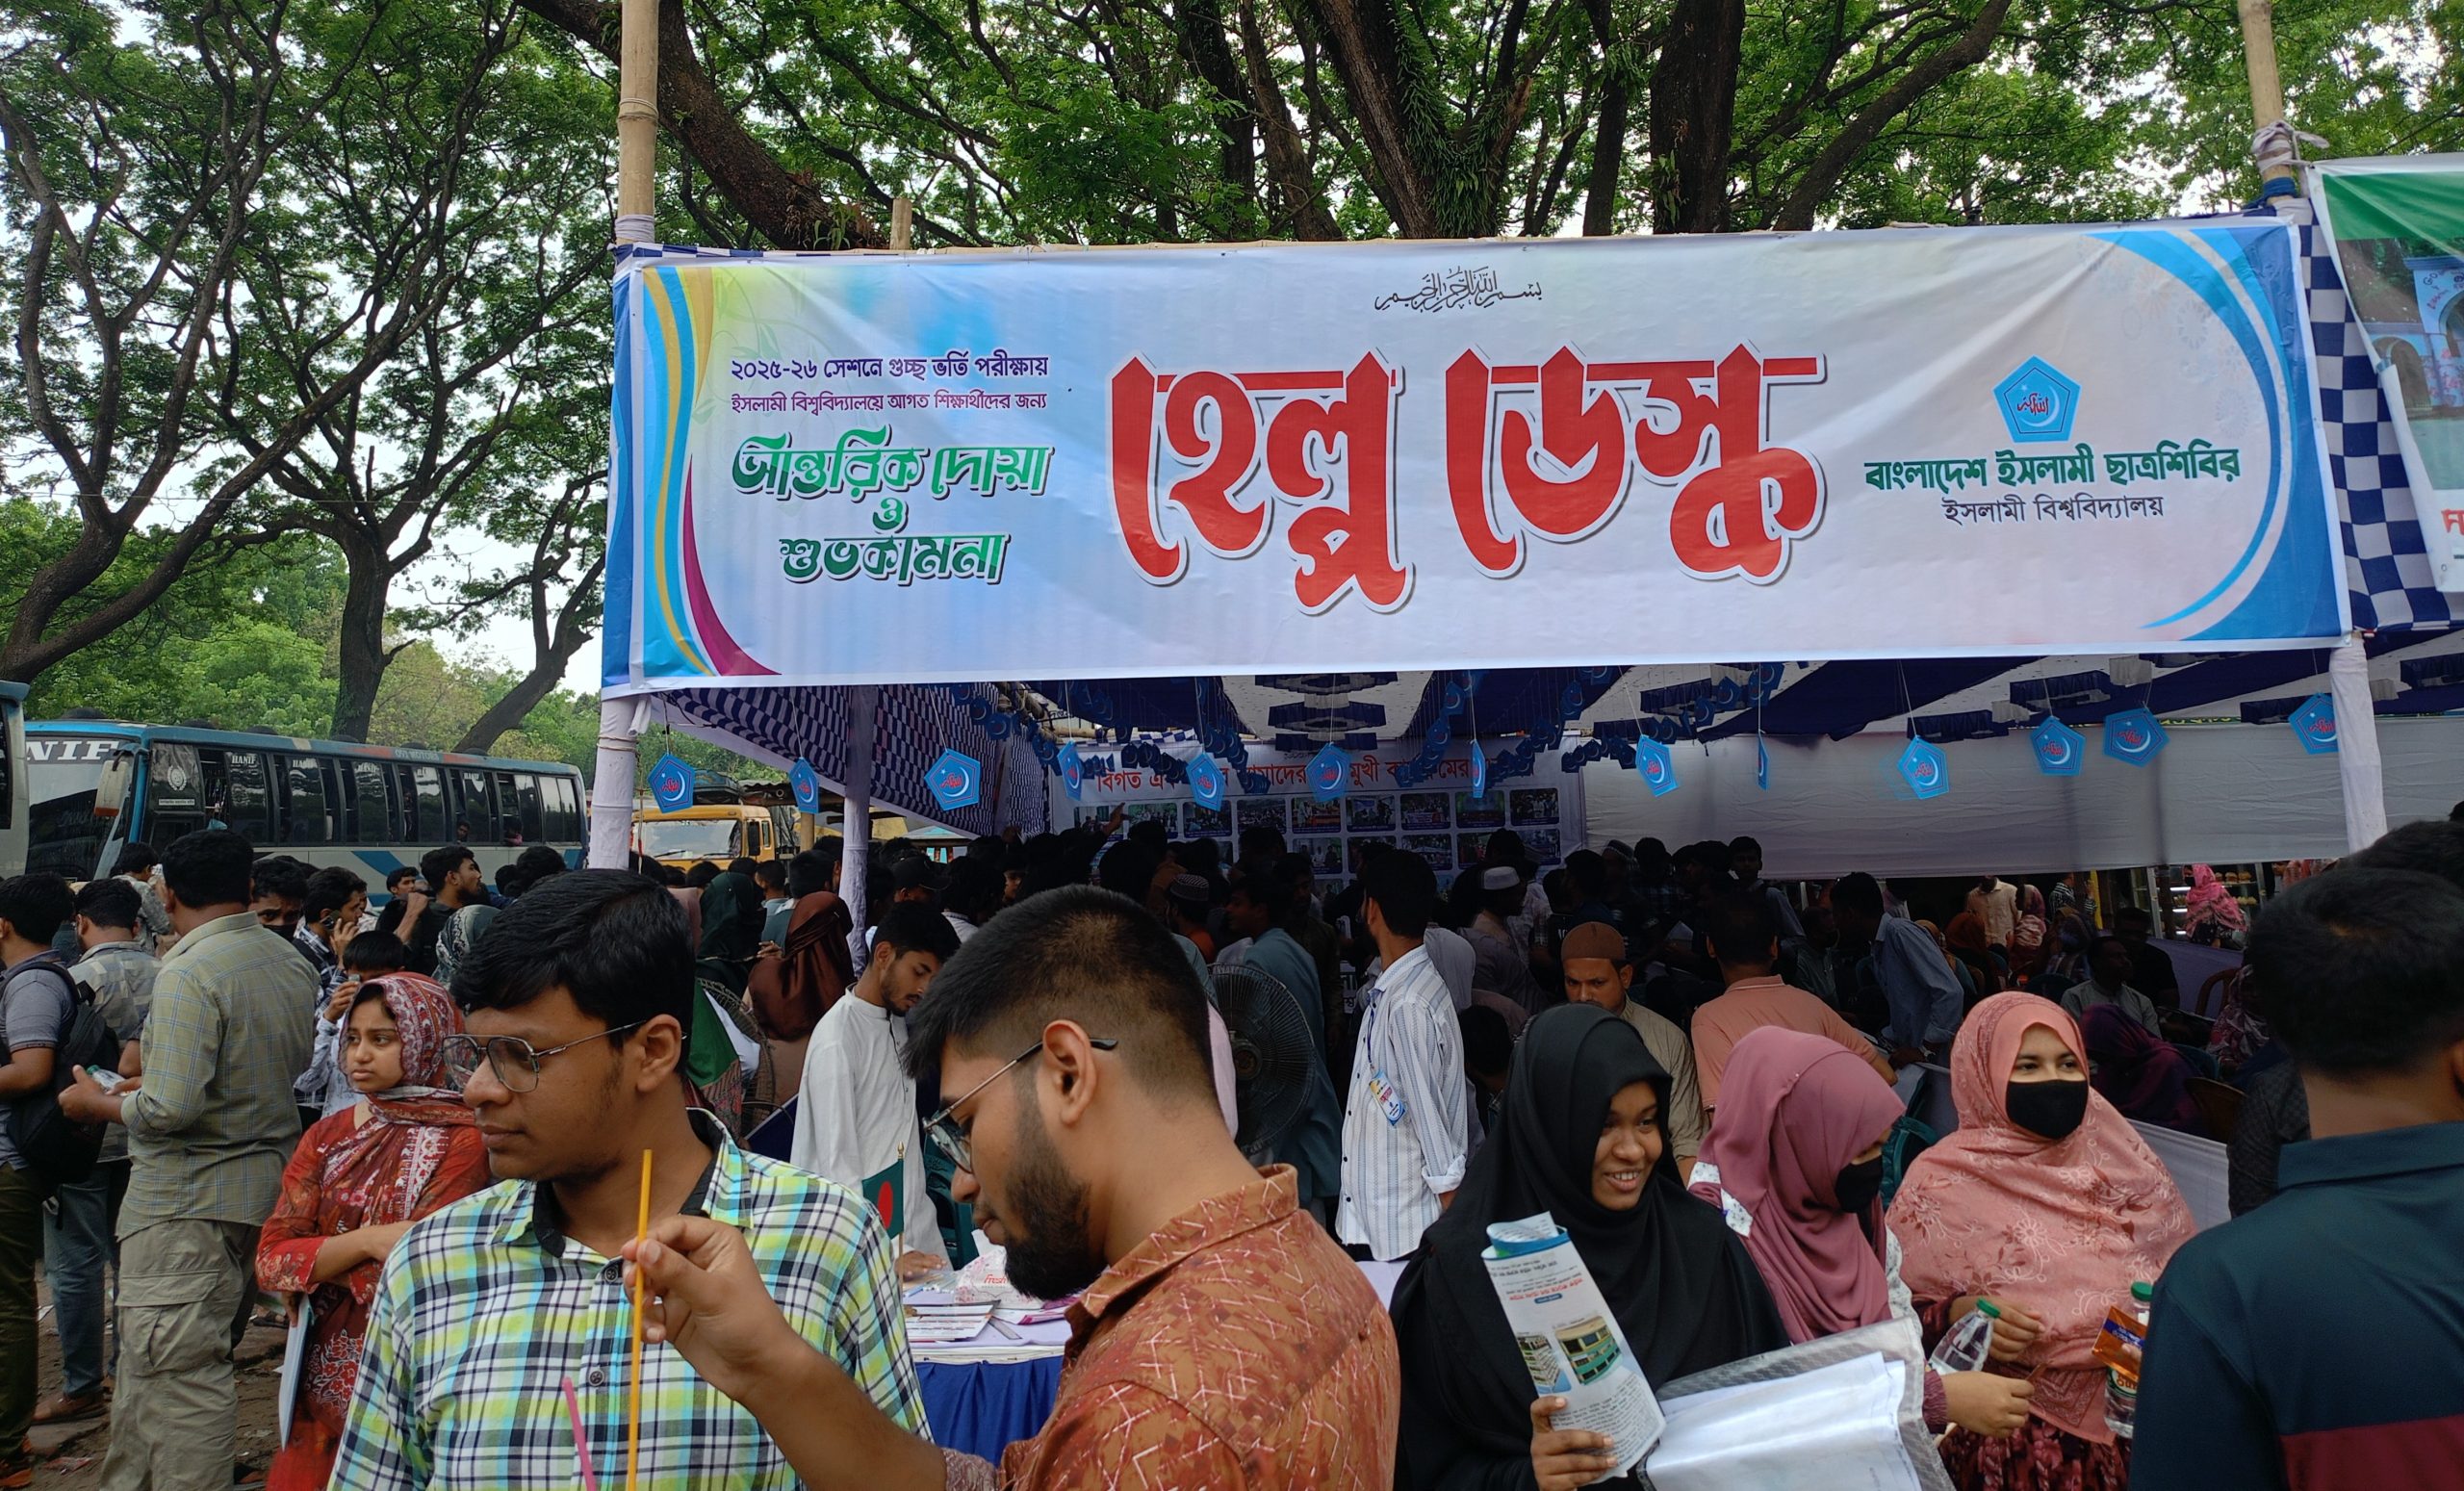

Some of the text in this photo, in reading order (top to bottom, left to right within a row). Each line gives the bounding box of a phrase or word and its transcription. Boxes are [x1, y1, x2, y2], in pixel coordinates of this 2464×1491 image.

[732, 348, 1049, 381] ২০২৫-২৬ সেশনে গুচ্ছ ভর্তি পরীক্ষায়
[732, 389, 1047, 416] ইসলামী বিশ্ববিদ্যালয়ে আগত শিক্ষার্থীদের জন্য
[732, 424, 1053, 501] আন্তরিক দোয়া
[1110, 342, 1823, 610] হেল্প ডেস্ক
[1863, 438, 2241, 494] বাংলাদেশ ইসলামী ছাত্রশিবির
[872, 497, 908, 532] ও
[1942, 491, 2164, 527] ইসলামী বিশ্ববিদ্যালয়
[779, 534, 1011, 585] শুভকামনা
[26, 740, 119, 760] NIF
